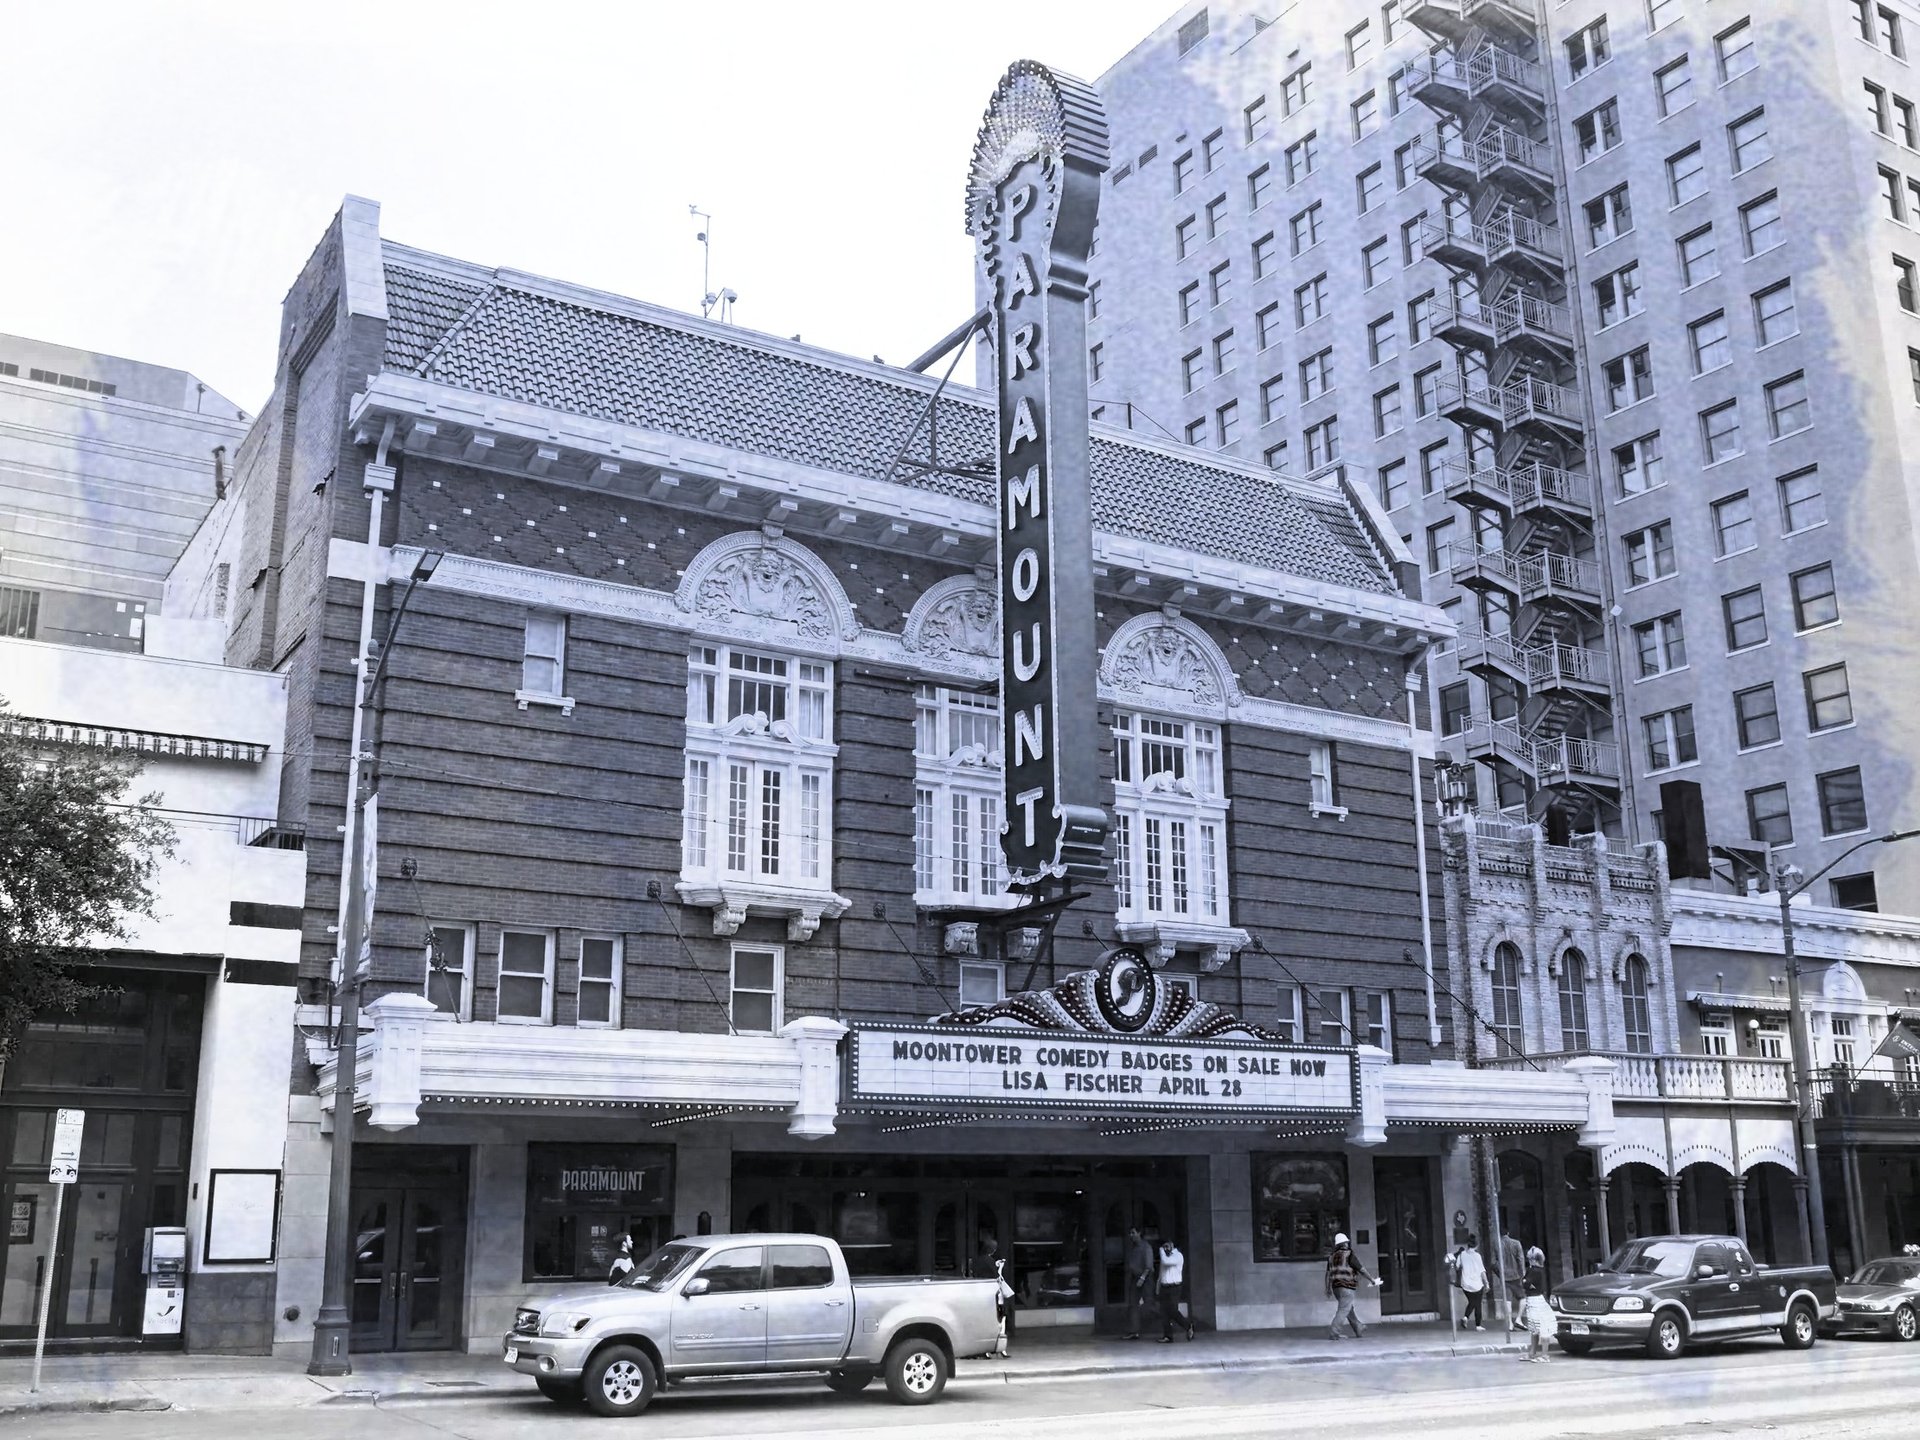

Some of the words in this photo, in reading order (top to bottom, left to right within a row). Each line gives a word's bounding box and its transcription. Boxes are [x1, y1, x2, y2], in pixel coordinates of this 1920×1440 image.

[1004, 183, 1044, 847] PARAMOUNT
[892, 1040, 1022, 1065] MOONTOWER
[1036, 1047, 1110, 1068] COMEDY
[1121, 1051, 1193, 1072] BADGES
[1203, 1055, 1228, 1074] ON
[1238, 1057, 1281, 1075] SALE
[1290, 1059, 1327, 1077] NOW
[1002, 1070, 1048, 1091] LISA
[1065, 1072, 1143, 1093] FISCHER
[1158, 1076, 1210, 1096] APRIL
[1221, 1079, 1242, 1097] 28
[562, 1170, 646, 1191] PARAMOUNT
